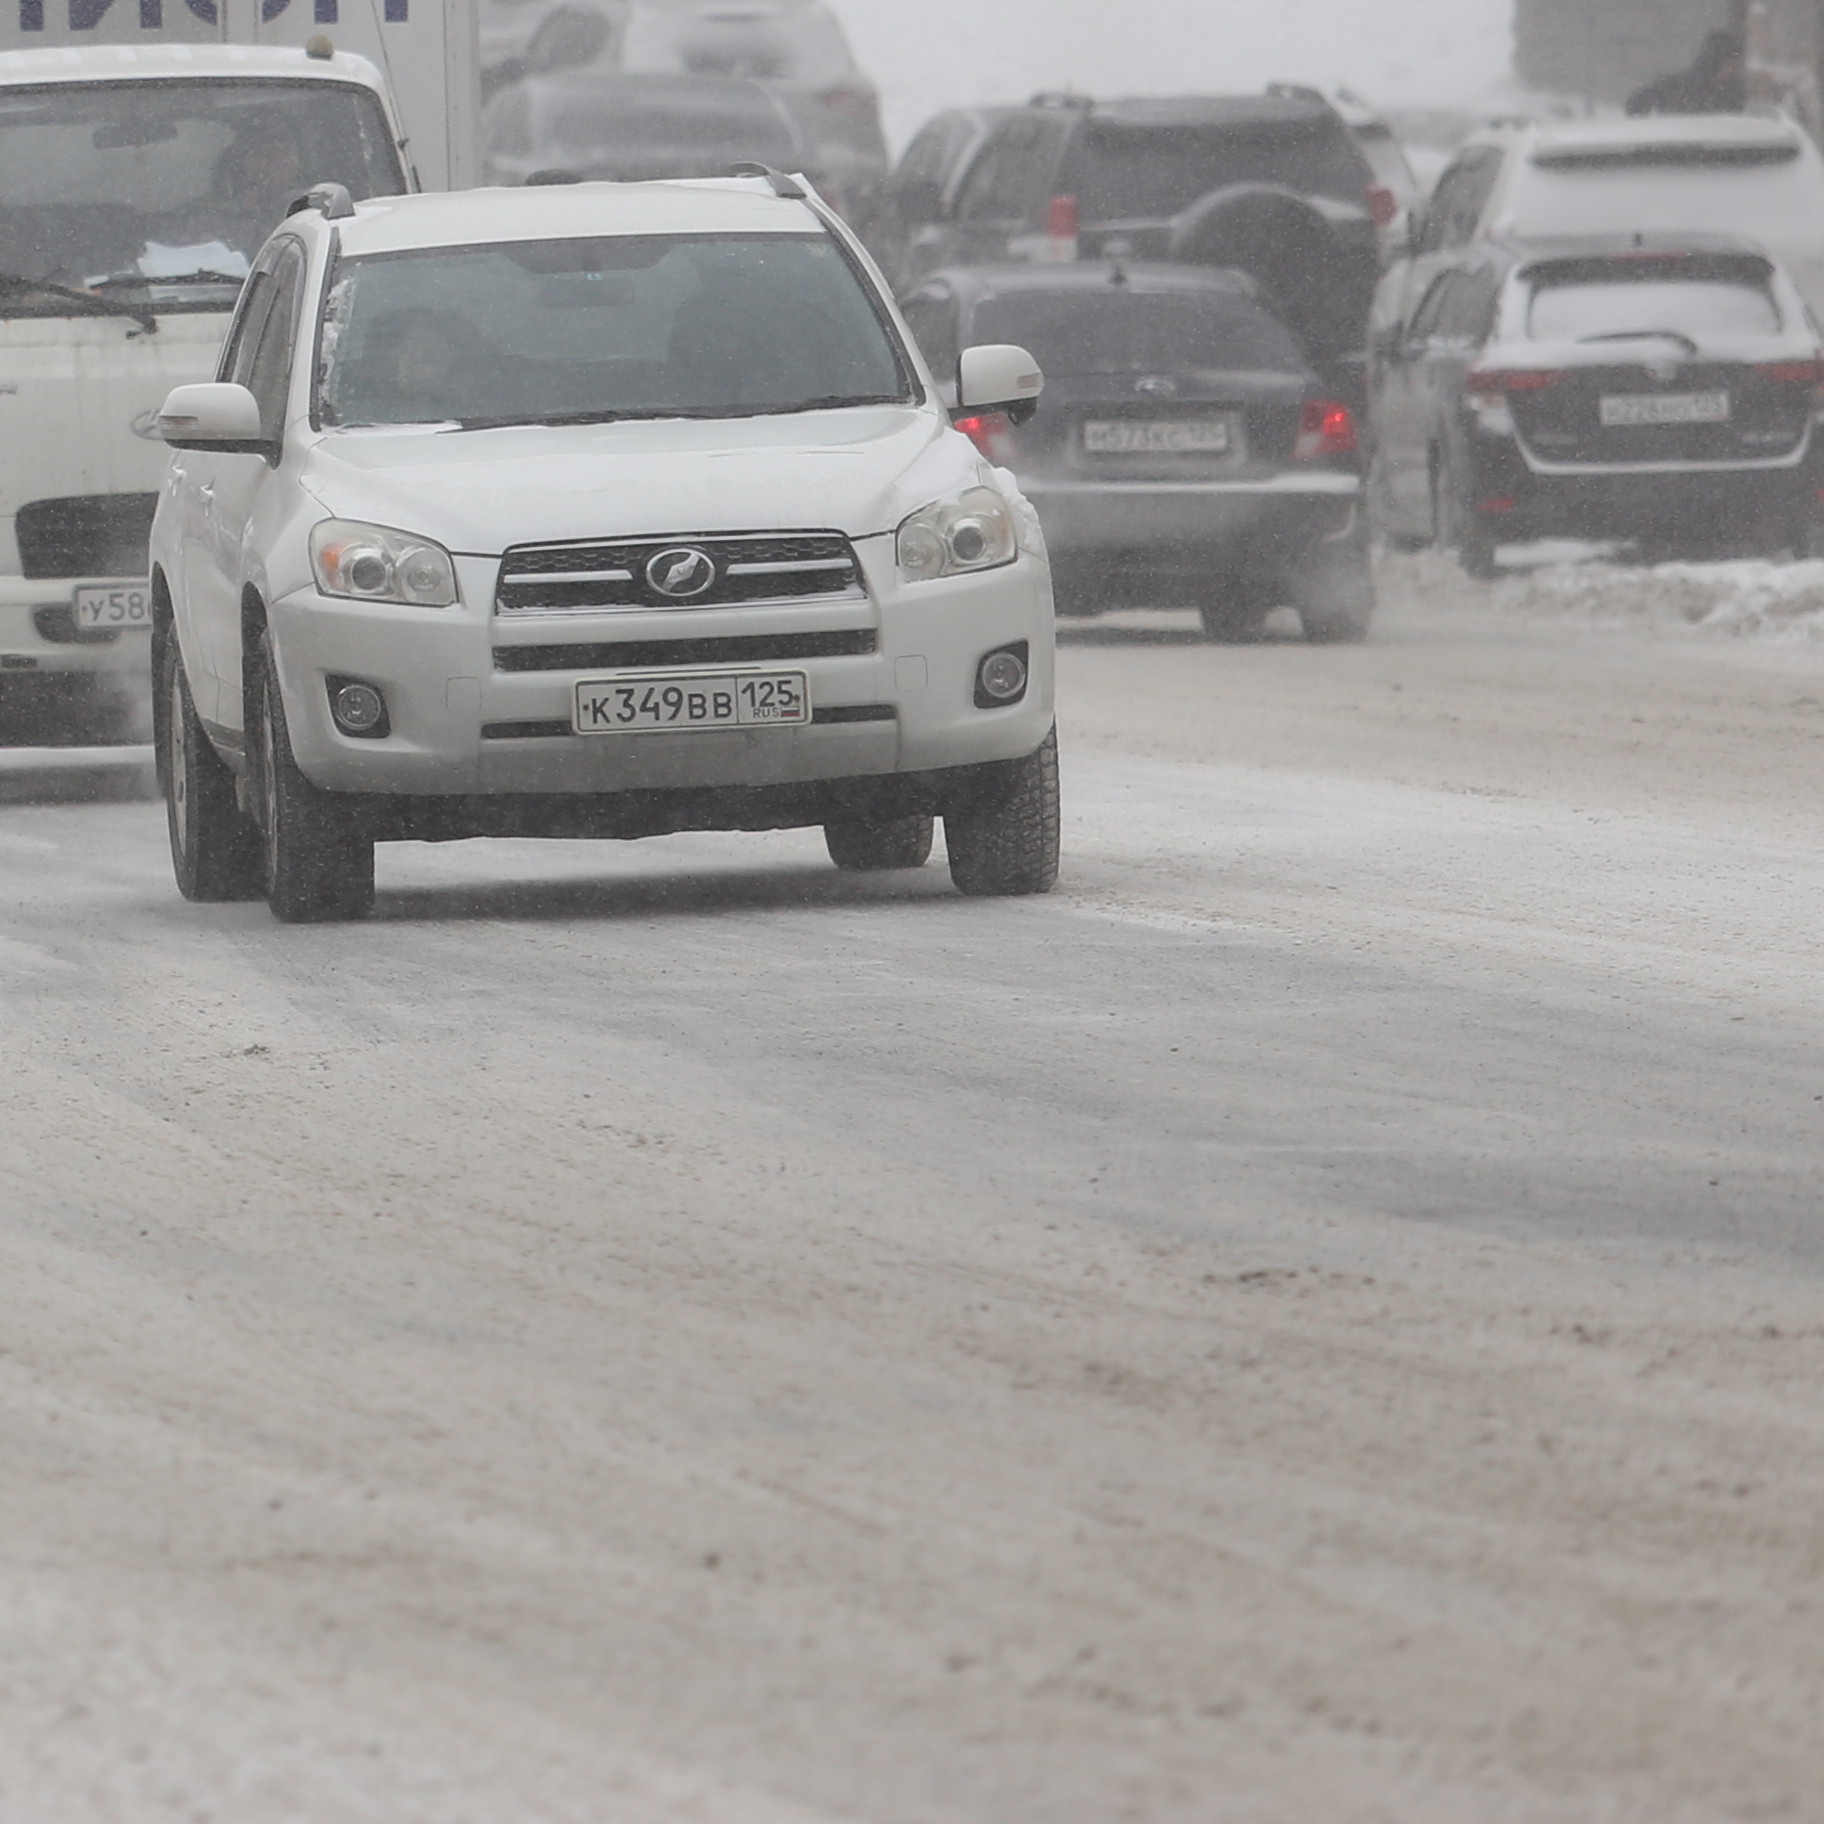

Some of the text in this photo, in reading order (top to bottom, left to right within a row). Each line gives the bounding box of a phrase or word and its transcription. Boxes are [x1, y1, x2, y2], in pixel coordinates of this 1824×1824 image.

[88, 592, 152, 622] У58
[591, 679, 795, 725] К349ВВ 125
[753, 706, 781, 719] RUS
